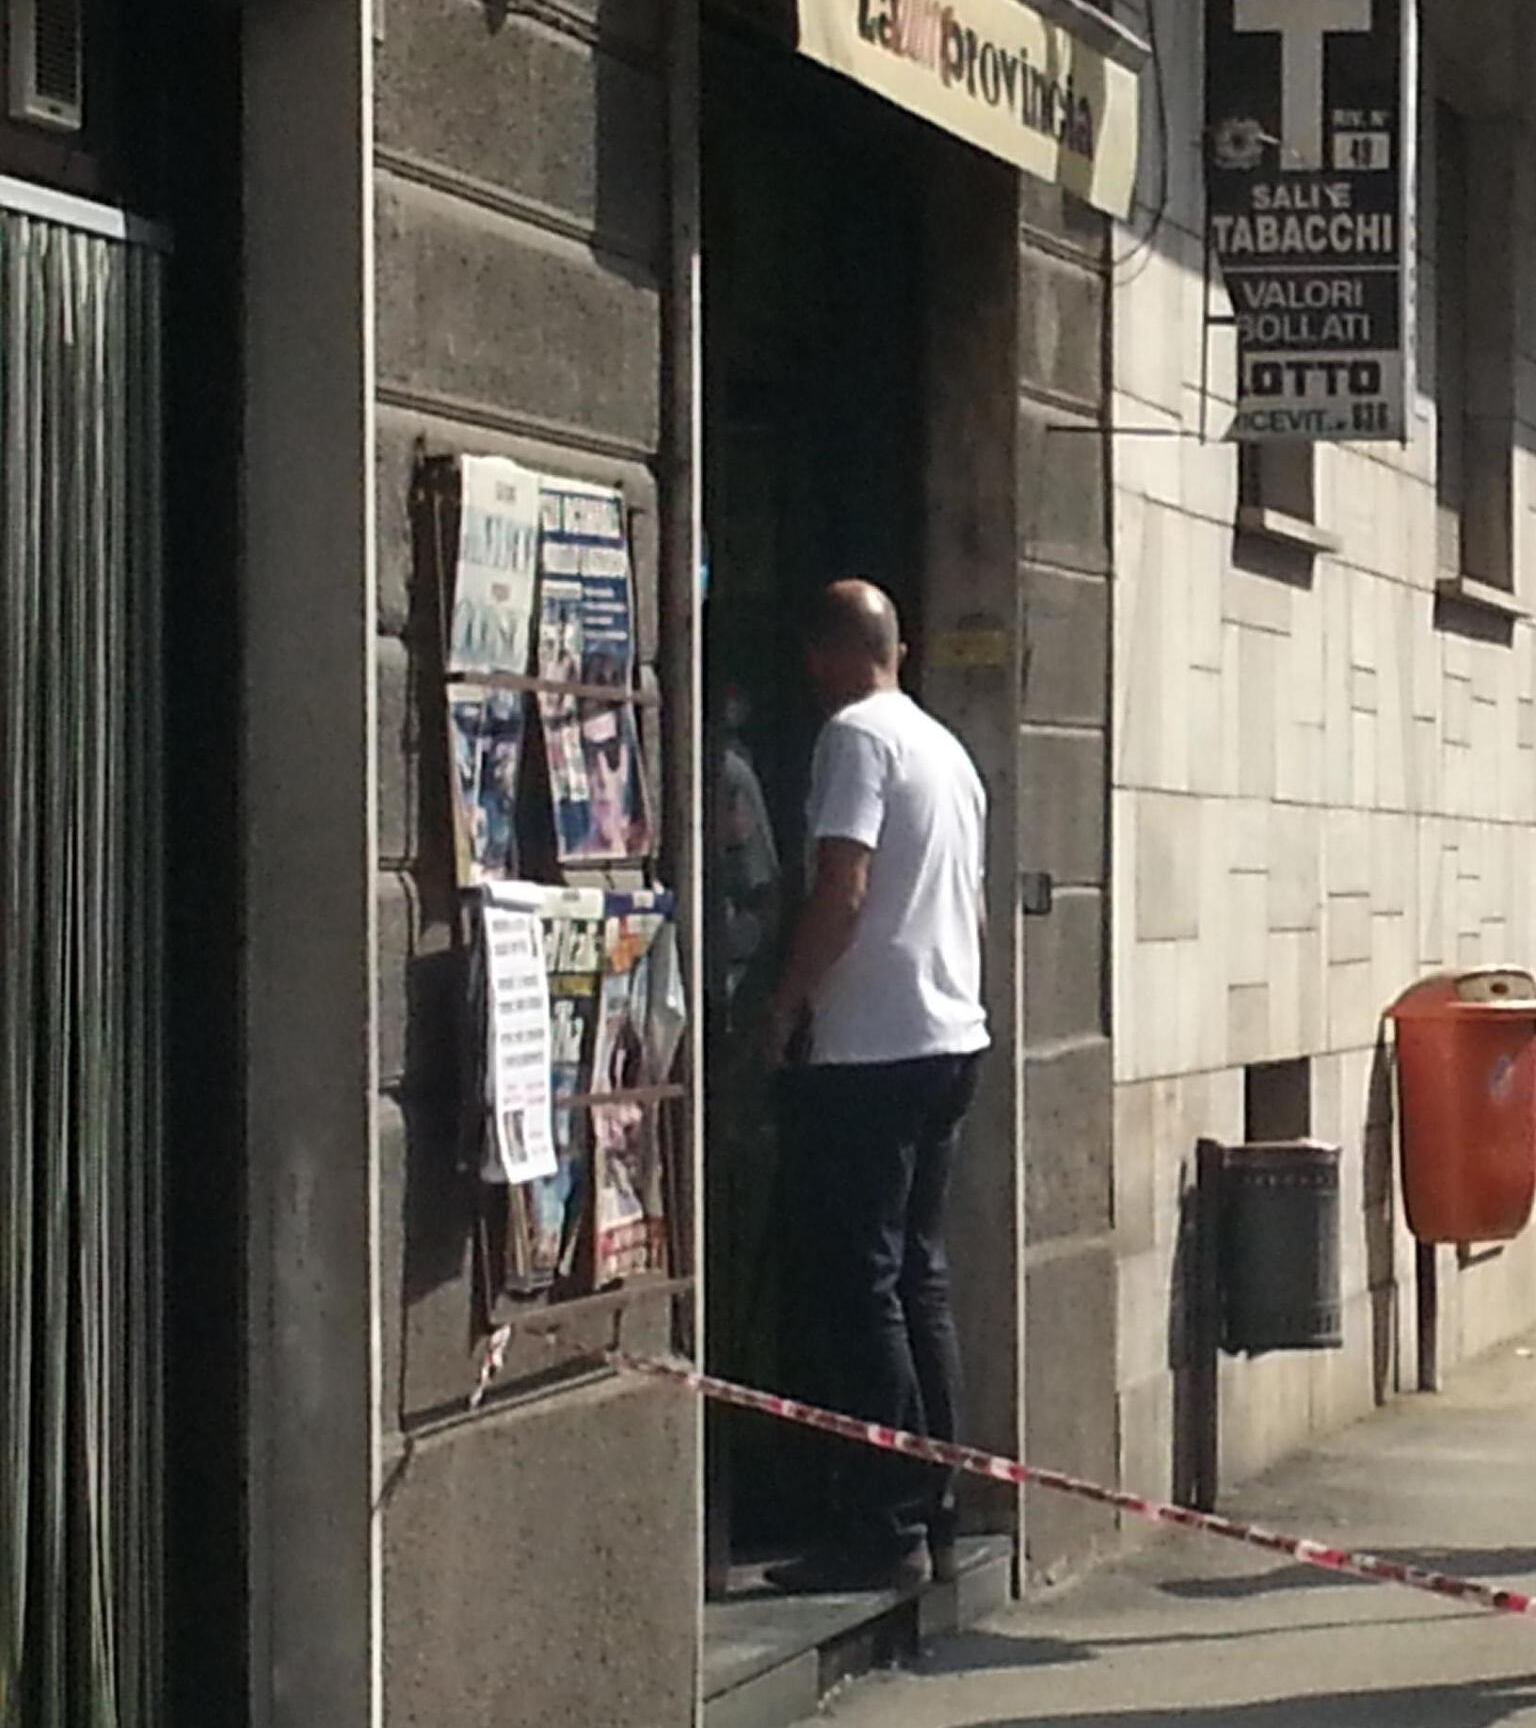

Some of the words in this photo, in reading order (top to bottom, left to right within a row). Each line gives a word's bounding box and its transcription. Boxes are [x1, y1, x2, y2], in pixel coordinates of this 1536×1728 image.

[1252, 184, 1320, 210] SALI
[1212, 213, 1393, 254] TABACCHI
[1242, 279, 1364, 310] VALORI
[1240, 359, 1382, 397] OTTO
